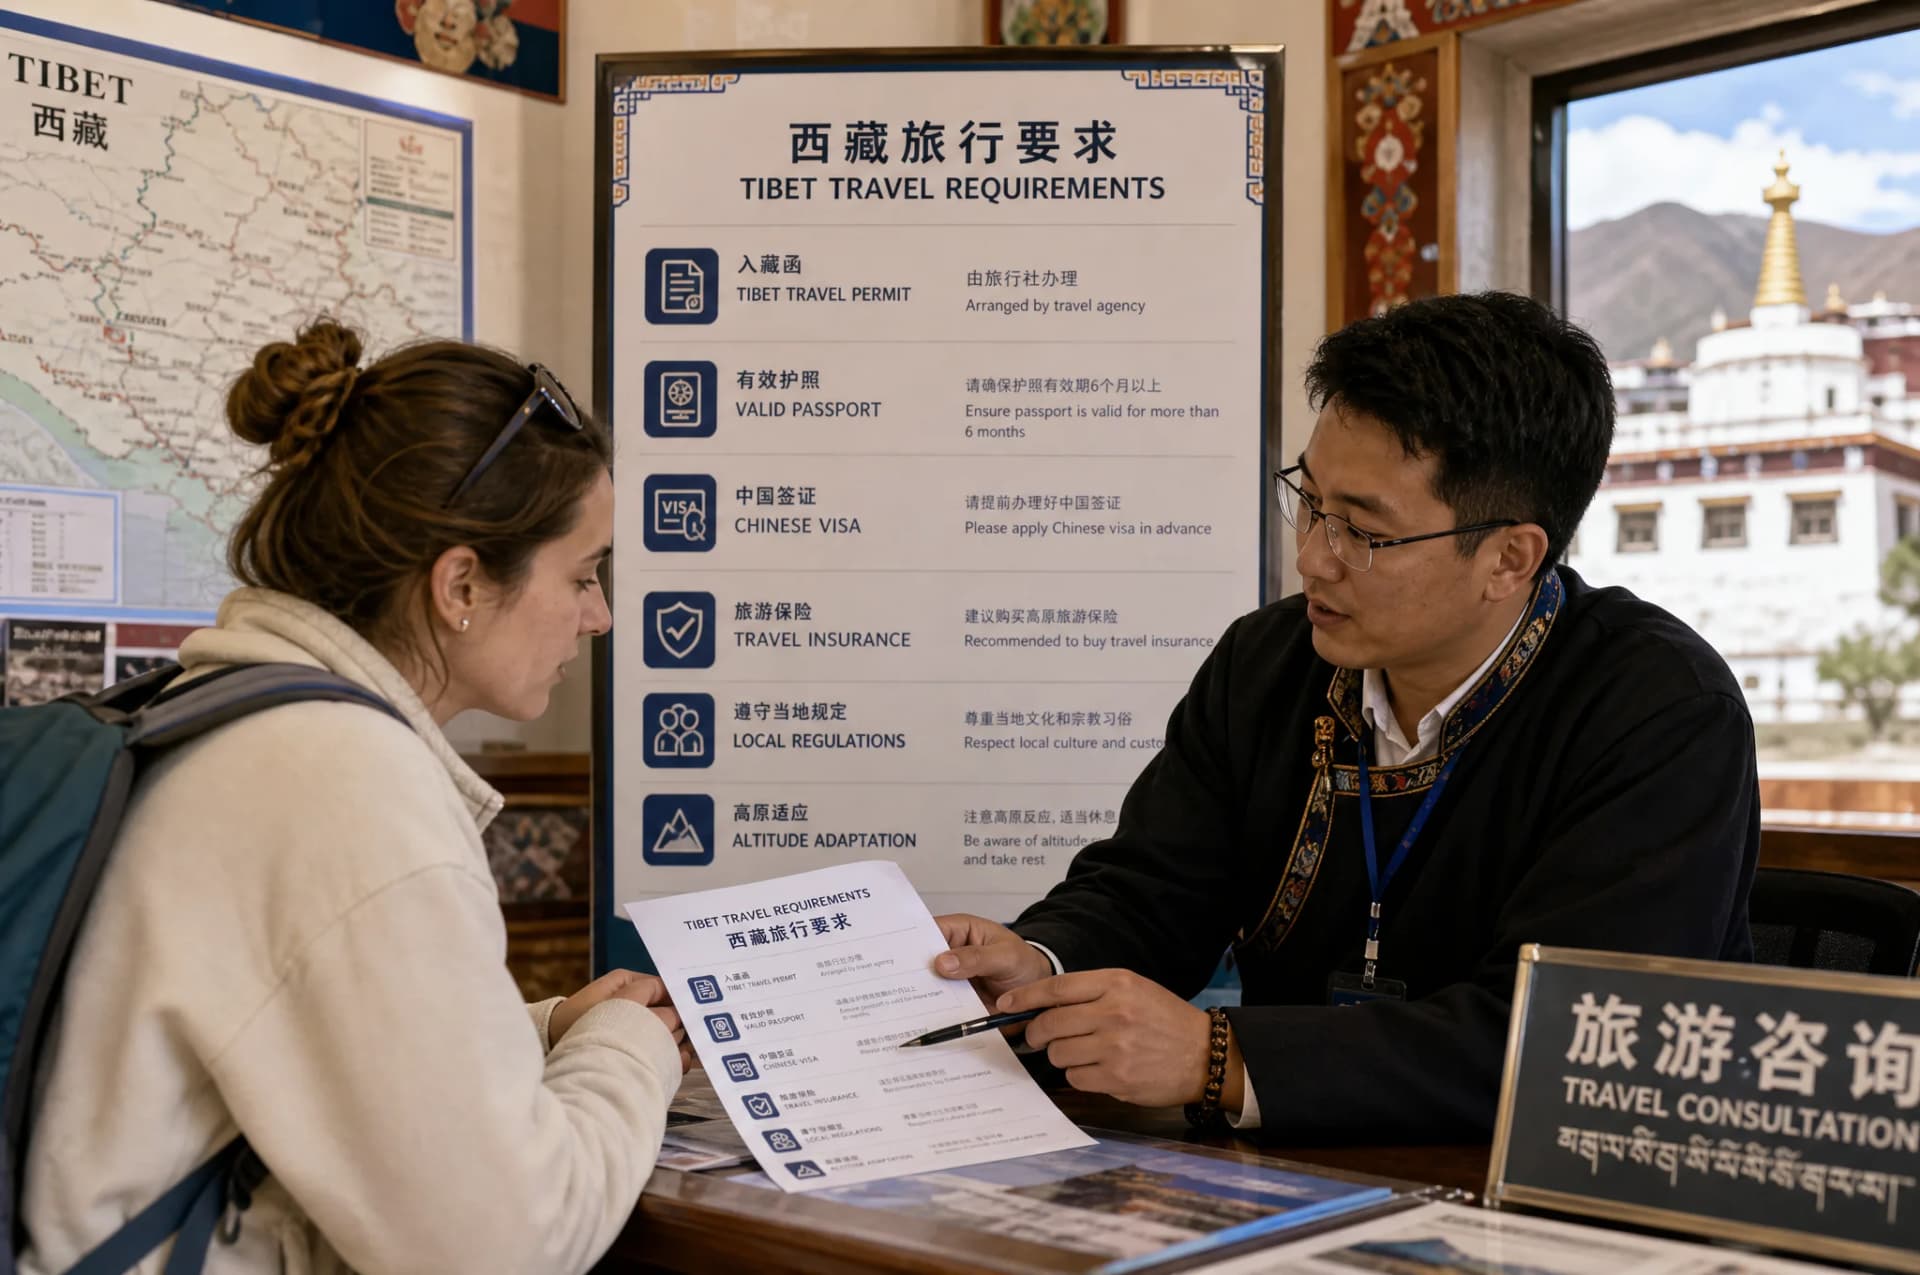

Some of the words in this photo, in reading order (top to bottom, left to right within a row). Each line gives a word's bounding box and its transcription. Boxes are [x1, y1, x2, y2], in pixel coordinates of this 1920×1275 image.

[8, 52, 134, 105] TIBET
[32, 102, 109, 151] 西藏
[789, 120, 1116, 164] 西藏旅行要求
[740, 178, 817, 200] TIBET
[828, 177, 934, 199] TRAVEL
[946, 176, 1165, 204] REQUIREMENTS
[738, 254, 801, 274] 入藏函
[968, 270, 1077, 287] 由旅行社办理
[737, 287, 781, 301] TIBET
[786, 287, 846, 301] TRAVEL
[852, 287, 911, 301] PERMIT
[966, 298, 1029, 315] Arranged
[1034, 299, 1049, 315] by
[1054, 299, 1092, 312] travel
[1097, 302, 1145, 315] agency
[737, 370, 819, 389] 有效护照
[966, 377, 1161, 393] 请确保护照有效期6个月以上
[736, 402, 785, 417] VALID
[793, 402, 882, 417] PASSPORT
[966, 404, 1011, 417] Ensure
[1015, 406, 1072, 420] passport
[1077, 405, 1087, 417] is
[1092, 404, 1122, 417] valid
[1127, 404, 1146, 417] for
[1151, 408, 1185, 418] more
[1190, 405, 1219, 417] than
[965, 425, 973, 438] 6
[977, 425, 1025, 438] months
[736, 485, 816, 505] 中国签证
[965, 495, 1120, 511] 请提前办理好中国签证
[662, 500, 698, 515] VISA
[735, 518, 811, 533] CHINESE
[819, 518, 861, 533] VISA
[965, 521, 1007, 534] Please
[1012, 521, 1048, 537] apply
[1052, 521, 1105, 534] Chinese
[1109, 522, 1135, 534] visa
[1140, 522, 1152, 534] in
[1156, 522, 1211, 535] advance
[735, 602, 812, 621] 旅游保险
[965, 608, 1118, 624] 建议购买高原旅游保险
[734, 632, 801, 647] TRAVEL
[809, 632, 911, 647] INSURANCE
[965, 634, 1061, 648] Recommended
[1065, 636, 1079, 647] to
[1083, 634, 1107, 650] buy
[1110, 635, 1147, 647] travel
[1151, 634, 1214, 648] insurance
[734, 702, 846, 720] 遵守当地规定
[965, 711, 1132, 726] 尊重当地文化和宗教习俗
[734, 733, 786, 748] LOCAL
[792, 733, 905, 748] REGULATIONS
[964, 736, 1015, 752] Respect
[1020, 736, 1049, 749] local
[1054, 737, 1098, 749] culture
[1102, 737, 1126, 749] and
[1130, 737, 1166, 749] custo
[734, 803, 808, 822] 高原适应
[733, 833, 808, 848] ALTITUDE
[814, 833, 916, 848] ADAPTATION
[964, 834, 980, 847] Be
[984, 838, 1021, 847] aware
[1025, 834, 1038, 847] of
[1041, 834, 1087, 847] altitude
[963, 852, 987, 865] and
[991, 854, 1017, 865] take
[1022, 855, 1045, 865] rest
[684, 916, 719, 931] TIBET
[722, 908, 771, 926] TRAVEL
[773, 888, 871, 917] REQUIREMENTS
[726, 912, 852, 950] 西藏旅行要求
[744, 1020, 767, 1031] VALID
[769, 1013, 806, 1026] PASSPORT
[1565, 992, 1920, 1110] 旅游咨询
[1562, 1076, 1669, 1118] TRAVEL
[1677, 1093, 1920, 1153] CONSULTATION
